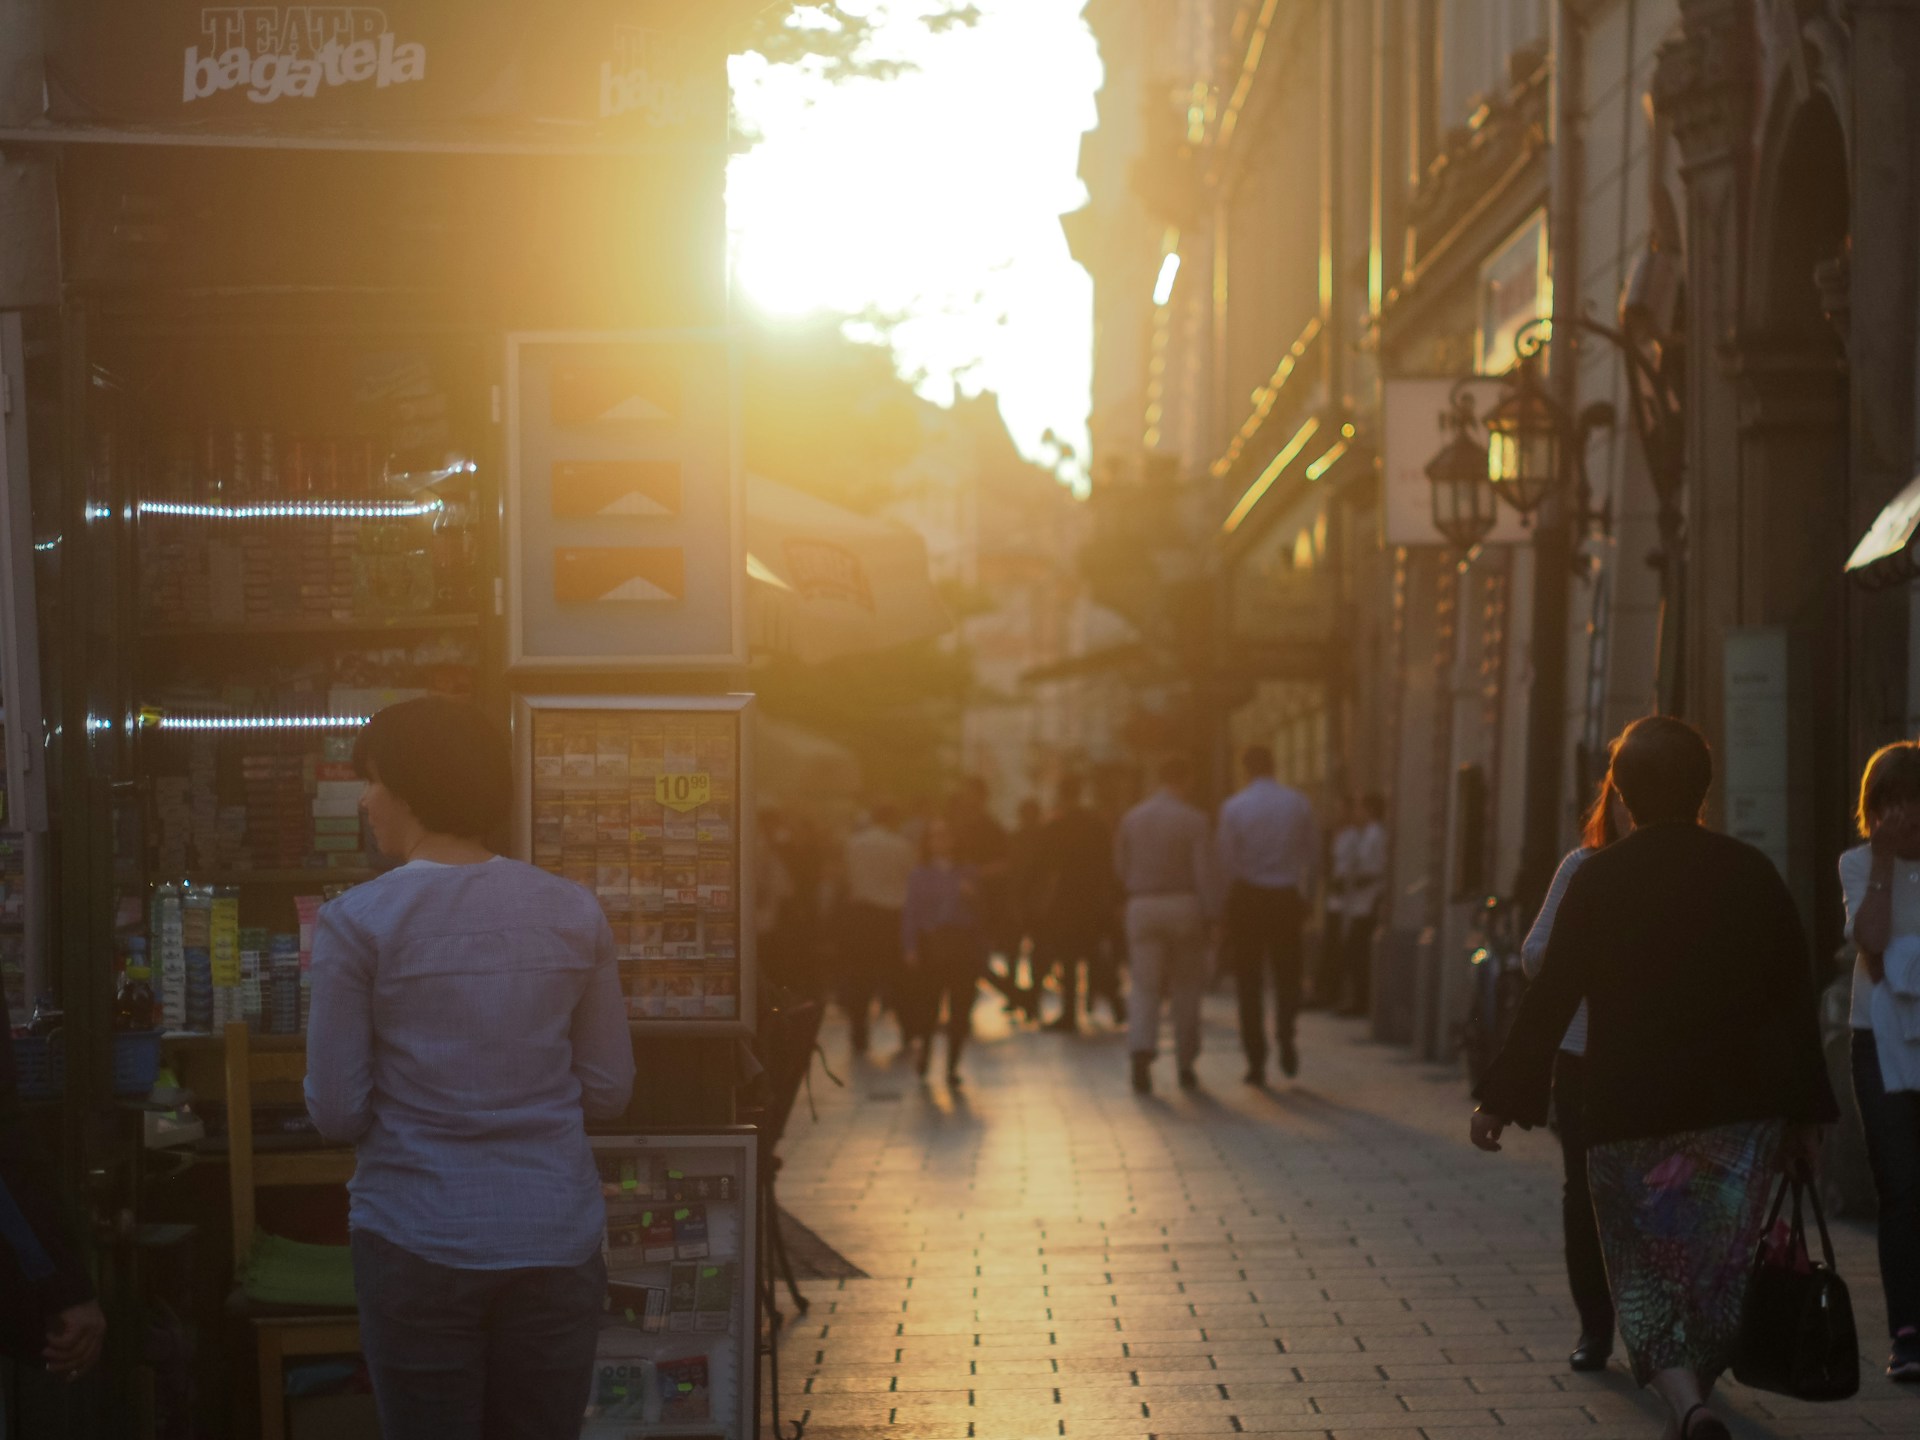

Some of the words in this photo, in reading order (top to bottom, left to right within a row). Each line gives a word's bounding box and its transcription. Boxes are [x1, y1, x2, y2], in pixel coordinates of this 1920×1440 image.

[201, 6, 388, 59] TEATR
[182, 32, 427, 104] bagatela
[602, 1365, 643, 1379] OCB
